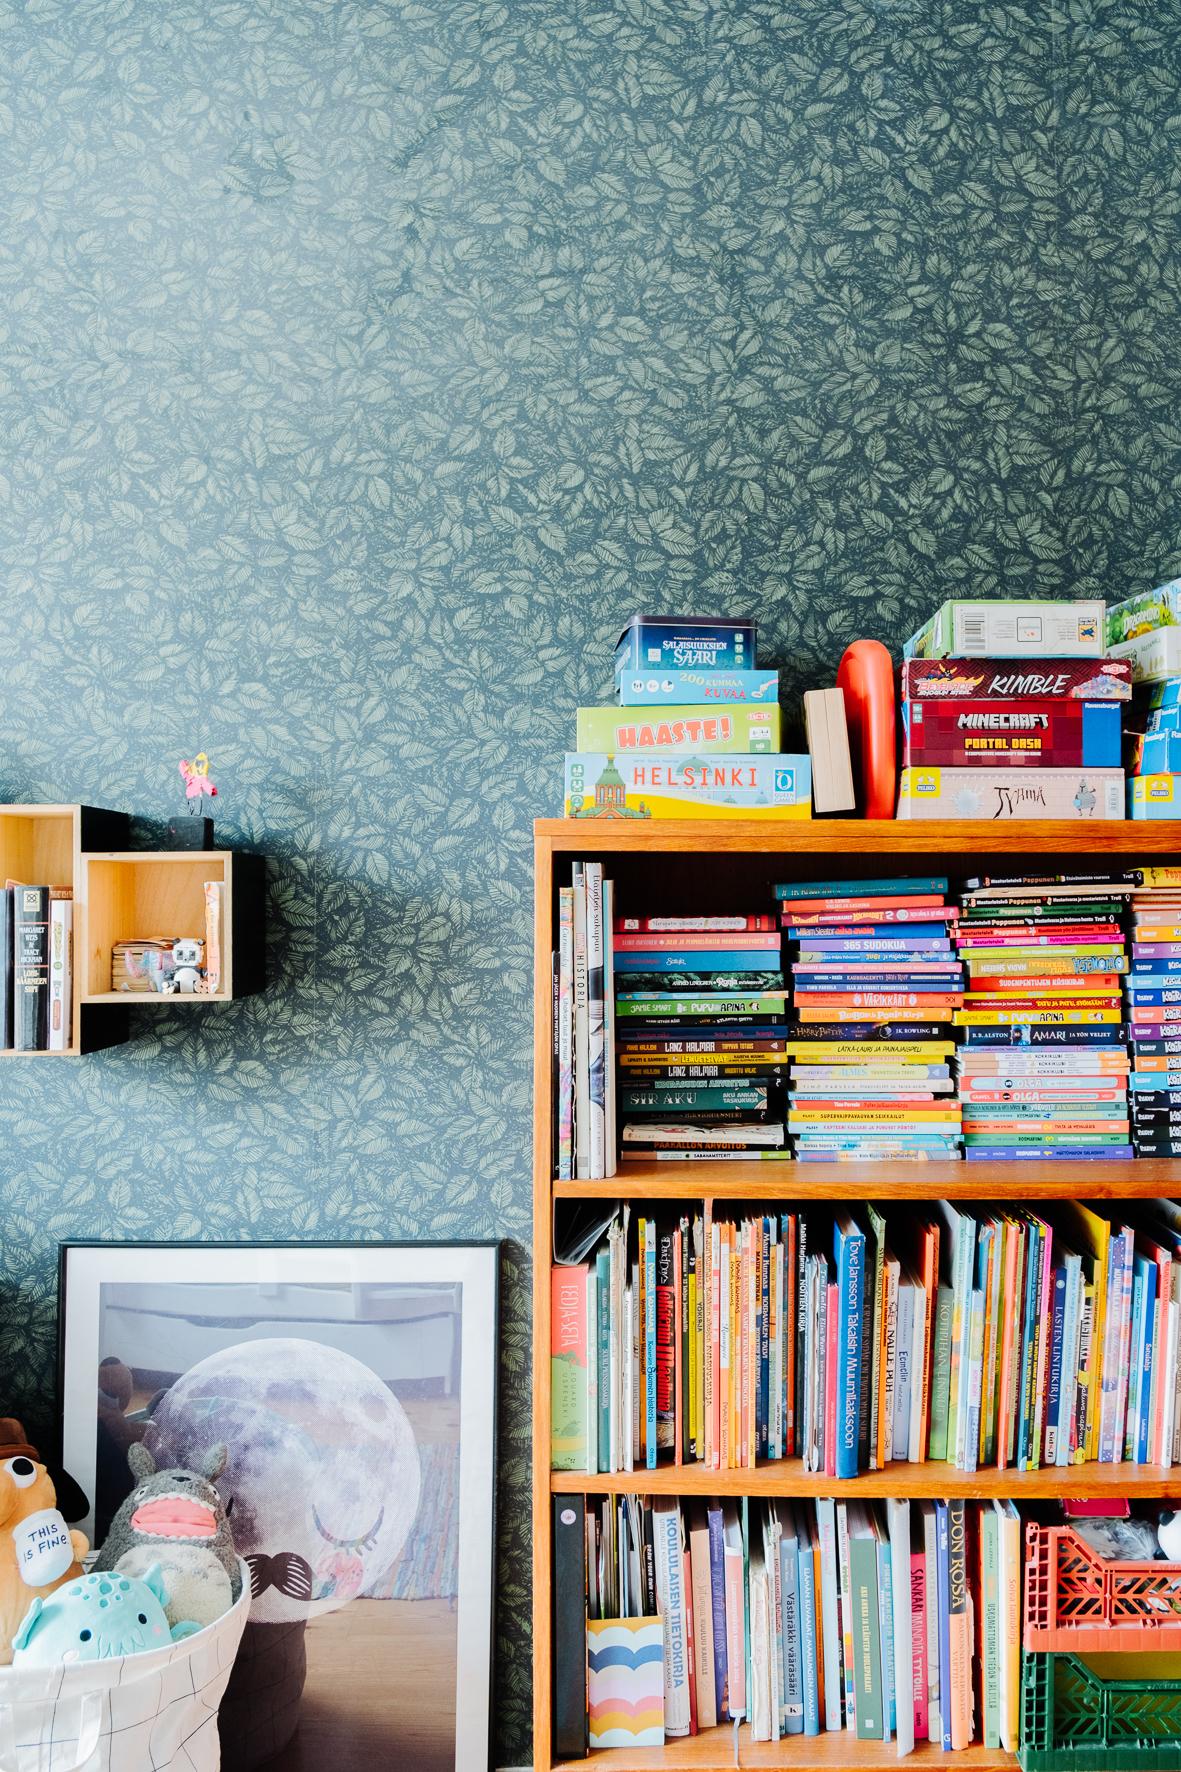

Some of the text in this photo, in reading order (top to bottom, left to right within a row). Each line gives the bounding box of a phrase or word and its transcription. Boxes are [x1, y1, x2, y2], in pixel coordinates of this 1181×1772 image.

[673, 650, 717, 666] SAARI
[679, 672, 705, 685] 200
[988, 674, 1071, 694] KIMBLE
[704, 687, 746, 700] KUVAA
[617, 716, 731, 748] HAASTE!
[958, 714, 1049, 730] MINECRAFT
[964, 738, 1042, 750] PORTAL DASH
[633, 767, 757, 787] HELSINKI
[1023, 877, 1055, 886] Peppunen
[1009, 898, 1041, 906] Peppunen
[992, 919, 1025, 928] Peppunen
[843, 941, 906, 950] 365 SUDOKUA
[577, 955, 585, 1009] HISTORIA
[720, 1003, 745, 1012] APINA
[1039, 1012, 1064, 1022] APINA
[797, 1026, 820, 1037] HARRY
[820, 1026, 844, 1038] POTTER
[1032, 1031, 1067, 1041] AMARI
[663, 1092, 697, 1104] AKU
[1012, 1091, 1040, 1102] OLGA
[876, 1268, 884, 1308] NORDQVIST
[560, 1285, 581, 1346] FEDJA-SETÄ
[798, 1312, 806, 1332] KIRJA
[1054, 1306, 1063, 1343] LASTEN
[844, 1239, 860, 1449] Tove Jansson Takaisin Muumilaaksoon
[937, 1304, 950, 1367] KOTIPIHAN
[656, 1286, 674, 1412] Tolkienin Maailma
[886, 1330, 896, 1392] NALLE PUH
[647, 1367, 656, 1395] Suomen
[1049, 1346, 1062, 1403] LINTUKIRJA
[27, 1523, 58, 1542] THIS
[24, 1549, 33, 1563] IS
[949, 1510, 966, 1609] DON ROSA
[803, 1568, 812, 1598] ELÄMÄN
[1008, 1578, 1016, 1602] Soiva
[667, 1518, 684, 1688] KOULULAISEN TIETOKIRJA
[986, 1603, 997, 1655] USKOMATTOMAN
[786, 1592, 797, 1696] Västäräkki vääräsääri
[988, 1657, 996, 1679] TIEDON
[913, 1658, 924, 1701] TYTÖILLE
